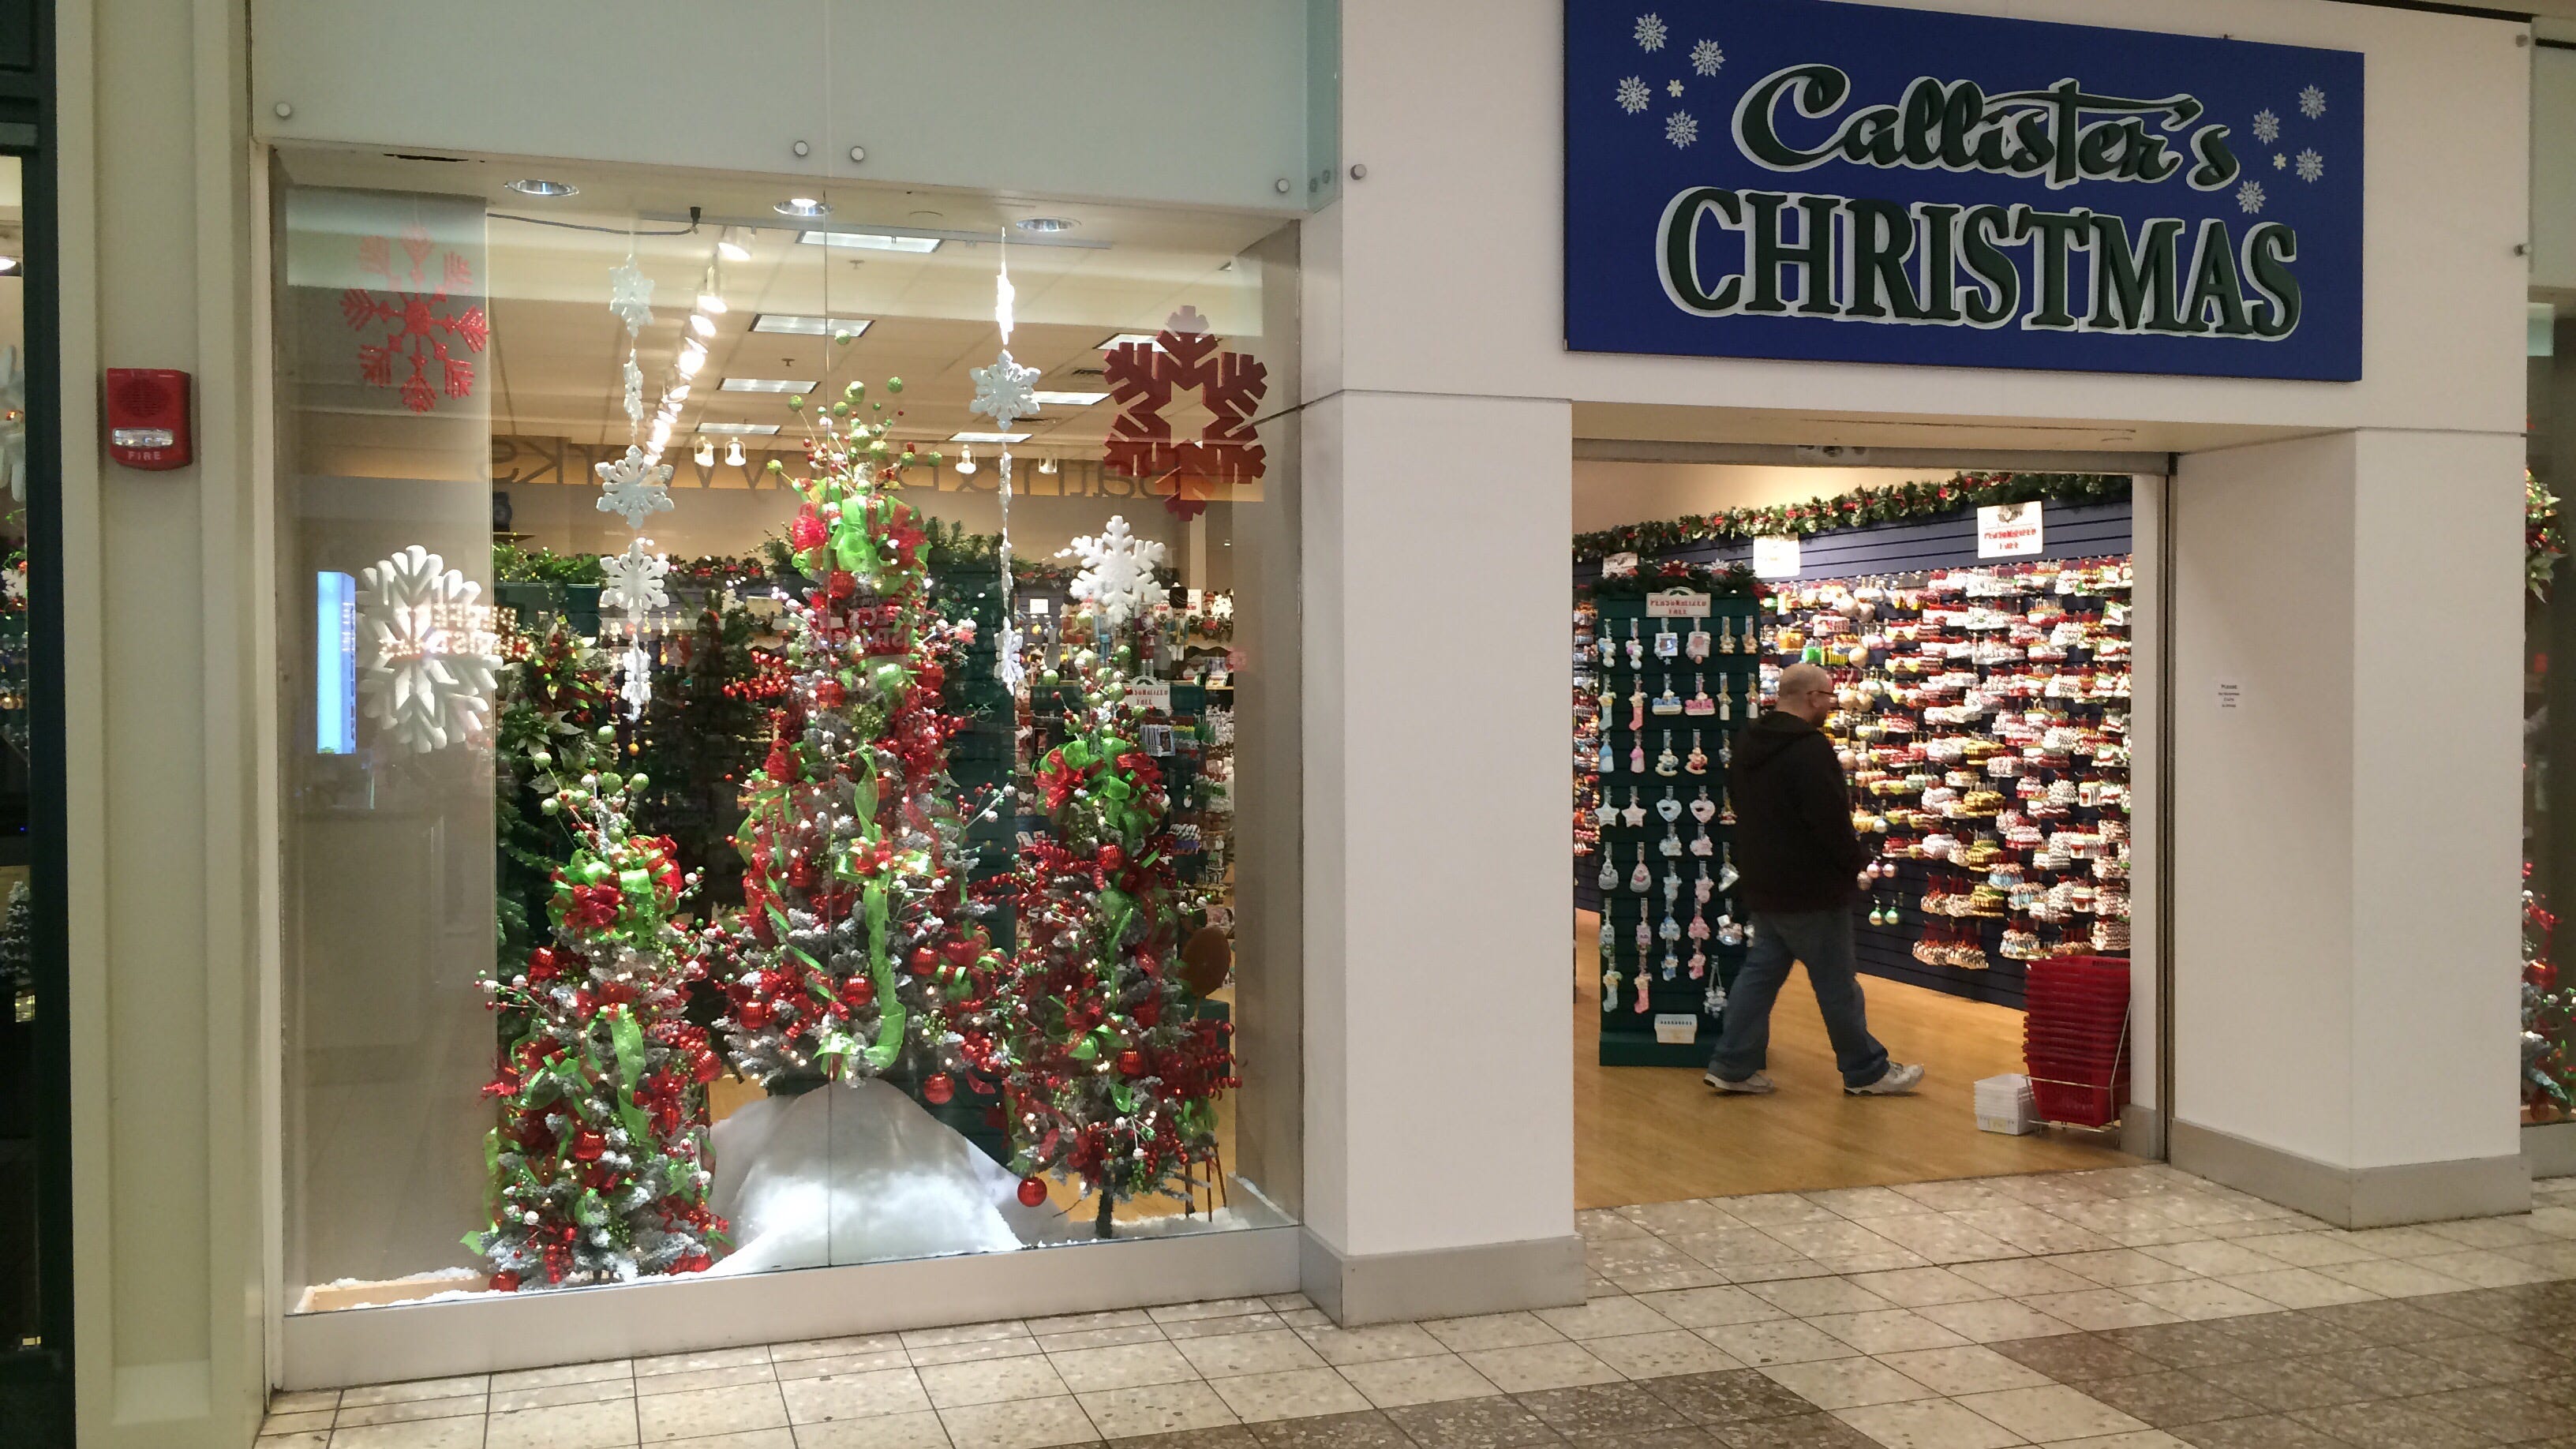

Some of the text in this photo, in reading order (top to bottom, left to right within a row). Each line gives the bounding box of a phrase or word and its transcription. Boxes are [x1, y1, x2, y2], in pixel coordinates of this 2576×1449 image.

[1732, 63, 2239, 191] Callister's
[1656, 186, 2302, 340] CHRISTMAS
[128, 451, 162, 460] FIRE
